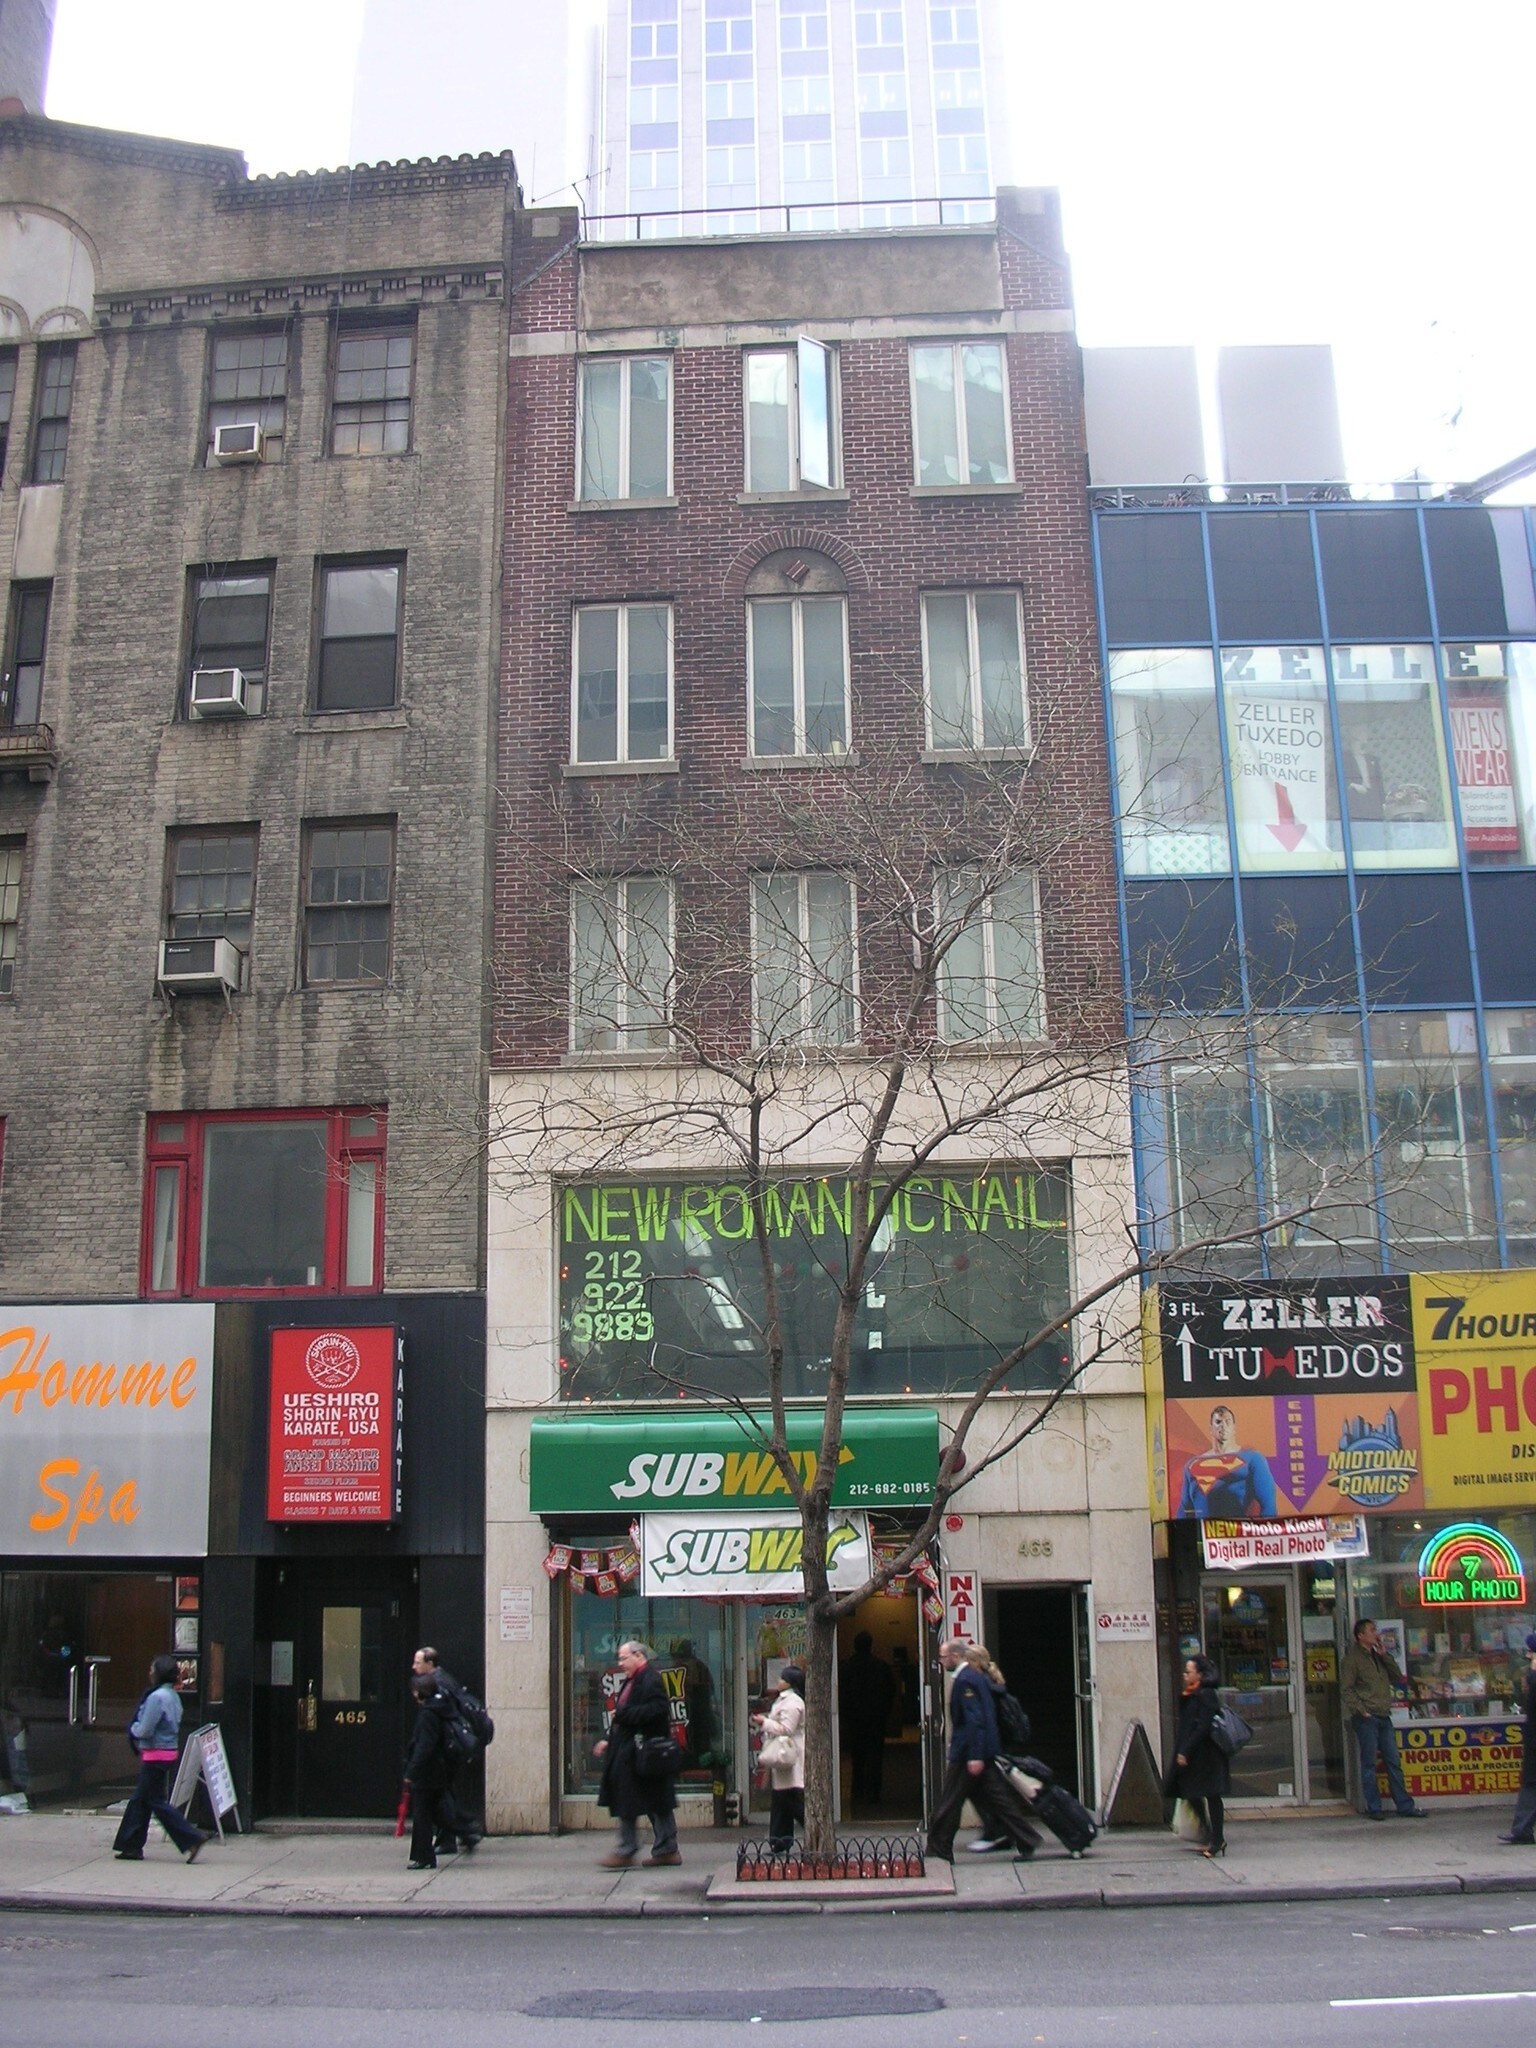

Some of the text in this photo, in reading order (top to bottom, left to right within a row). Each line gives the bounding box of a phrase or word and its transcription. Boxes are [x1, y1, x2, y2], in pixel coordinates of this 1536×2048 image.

[1239, 703, 1315, 725] ZELLER
[1235, 723, 1323, 748] TUXEDO
[1451, 711, 1503, 749] MENS
[1259, 750, 1300, 766] LOBBY
[1454, 750, 1509, 785] WEAR
[1243, 764, 1317, 783] ENTRANCE
[564, 1186, 671, 1242] NEW
[942, 1175, 1067, 1232] NAIL
[584, 1250, 642, 1279] 212
[583, 1281, 647, 1312] 922
[1168, 1302, 1205, 1317] 3 FL.
[1221, 1296, 1385, 1331] ZELLER
[1424, 1296, 1536, 1340] 7 HOUR
[310, 1335, 355, 1359] SHORIN-RYU
[0, 1325, 197, 1416] Homme
[283, 1392, 379, 1407] UESHIRO
[283, 1406, 379, 1421] SHORIN-RYU
[283, 1421, 379, 1437] KARATE, USA
[395, 1338, 405, 1513] KARATE
[283, 1449, 379, 1460] GRAND MASTER
[1287, 1400, 1306, 1497] ENTRANCE
[1327, 1449, 1417, 1470] MIDTOWN
[325, 1459, 379, 1472] UESHIRO
[1338, 1474, 1411, 1496] COMICS
[1453, 1473, 1485, 1486] DIGITAL
[1486, 1472, 1513, 1484] IMAGE
[30, 1458, 142, 1547] Spa
[283, 1490, 381, 1503] BEGINNERS WELCOME!
[1205, 1515, 1325, 1538] NEW Photo Kiosk
[1018, 1539, 1053, 1557] 463
[1207, 1535, 1326, 1562] Digital Real Photo
[1460, 1555, 1481, 1580] 7
[1425, 1579, 1518, 1601] HOUR PHOTO
[774, 1609, 797, 1619] 463
[335, 1711, 367, 1724] 465
[1405, 1749, 1452, 1764] HOUR
[1459, 1748, 1483, 1761] OR
[1423, 1764, 1456, 1773] COLOR
[1458, 1763, 1480, 1771] FILM
[1420, 1773, 1462, 1792] FILM
[1473, 1771, 1520, 1790] FREE
